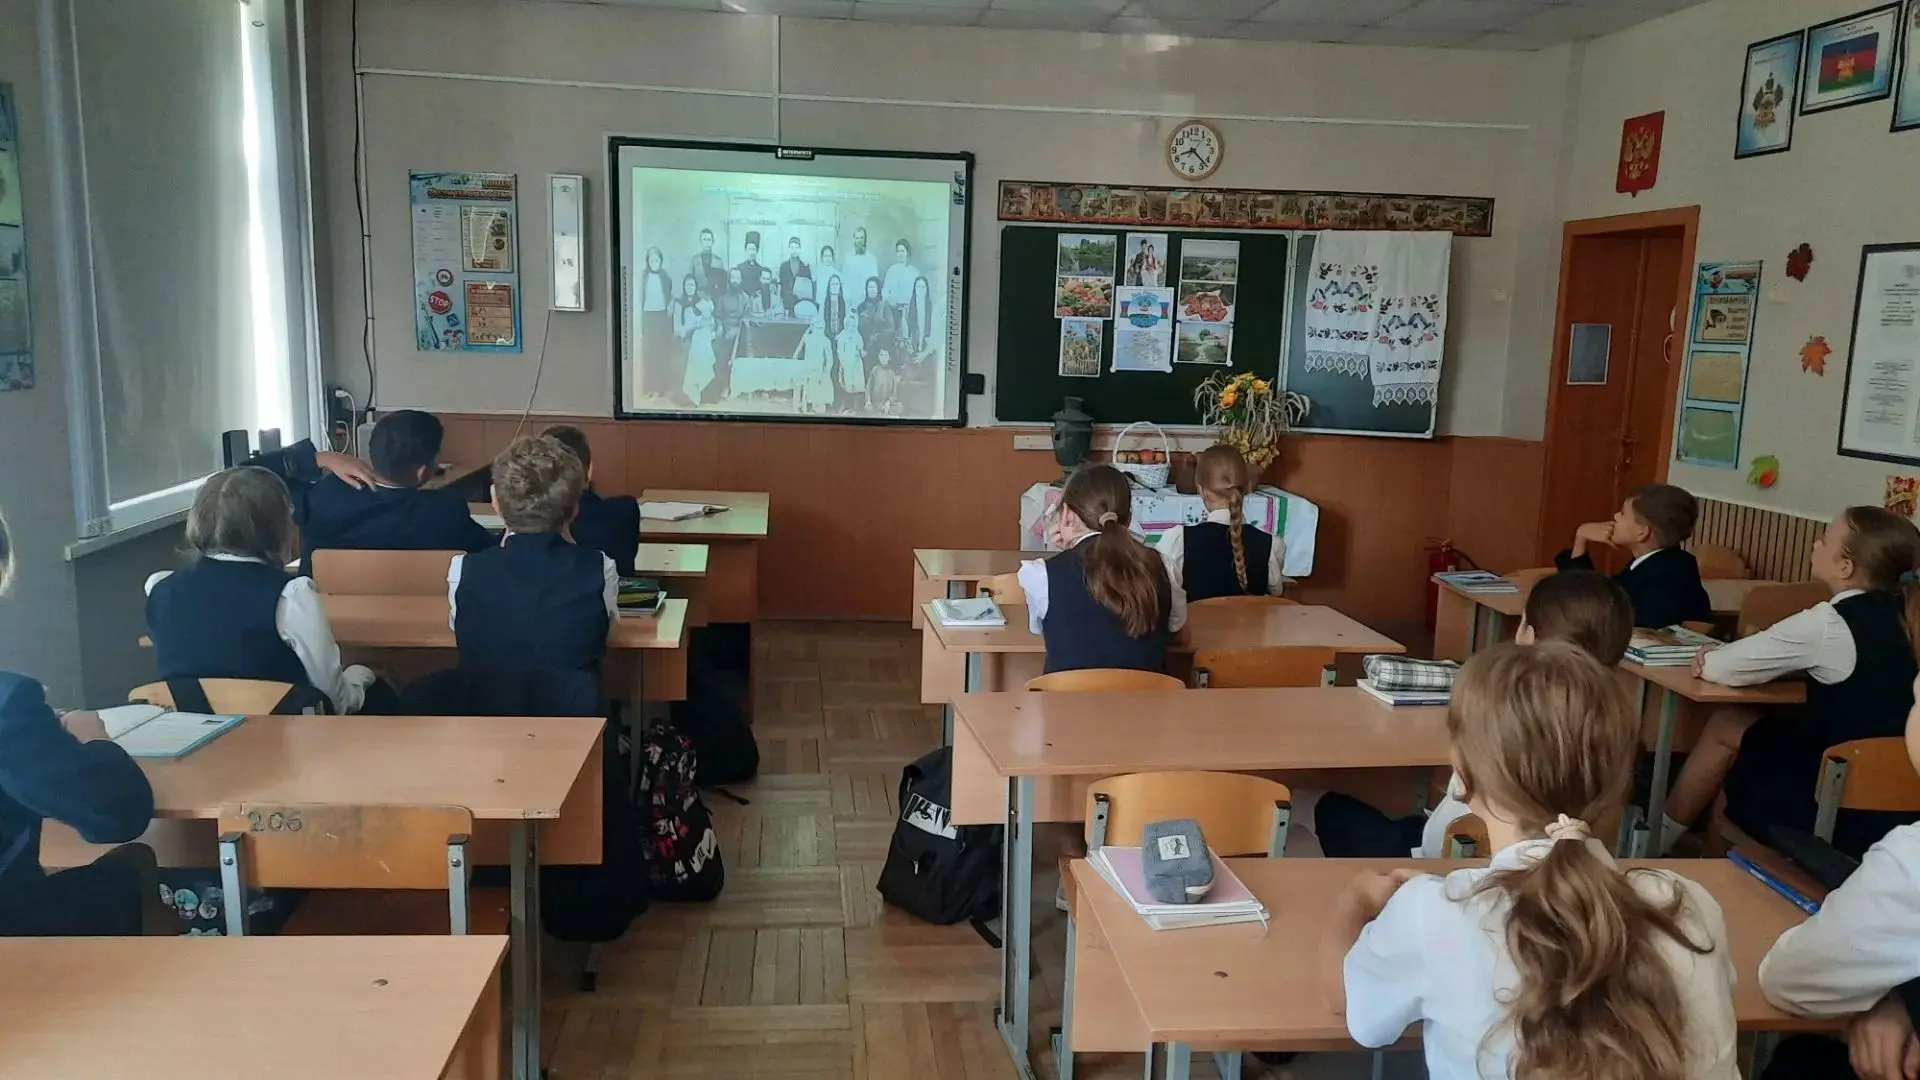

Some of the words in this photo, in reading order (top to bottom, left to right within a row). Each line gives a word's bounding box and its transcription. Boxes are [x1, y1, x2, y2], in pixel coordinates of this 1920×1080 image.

[1182, 130, 1190, 139] 11
[1190, 128, 1199, 136] 12
[1201, 131, 1206, 139] 1
[1175, 138, 1184, 146] 10
[1206, 138, 1212, 147] 2
[1171, 146, 1178, 154] 9
[1209, 147, 1215, 155] 3
[1174, 155, 1180, 163] 8
[1198, 163, 1204, 171] 5
[430, 294, 450, 306] STOP
